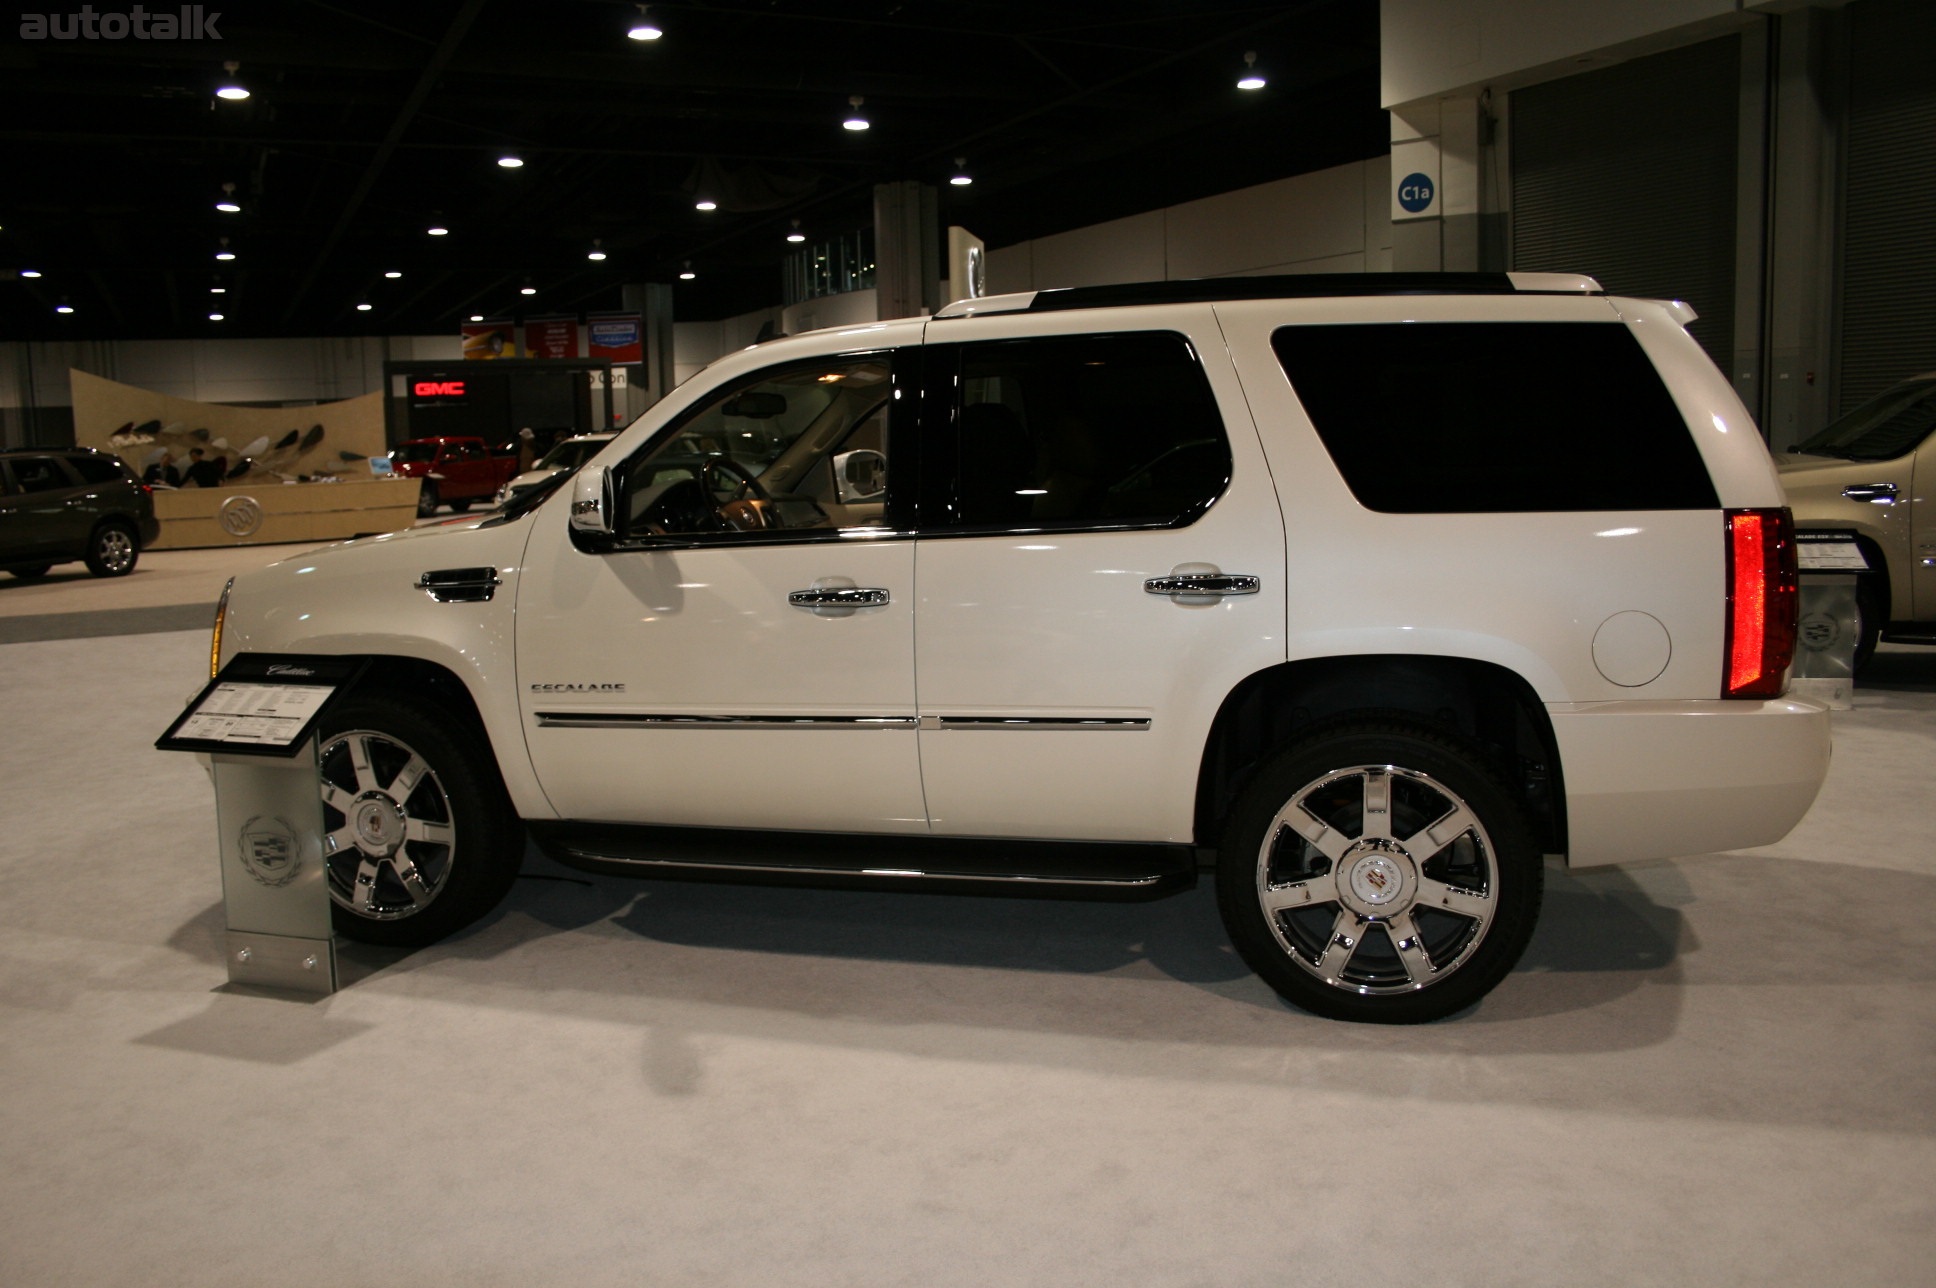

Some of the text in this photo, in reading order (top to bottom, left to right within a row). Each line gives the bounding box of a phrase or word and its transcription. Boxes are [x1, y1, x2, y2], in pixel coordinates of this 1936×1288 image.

[1401, 186, 1430, 200] C1a
[415, 381, 465, 396] GMC
[531, 683, 625, 693] ESCALADE
